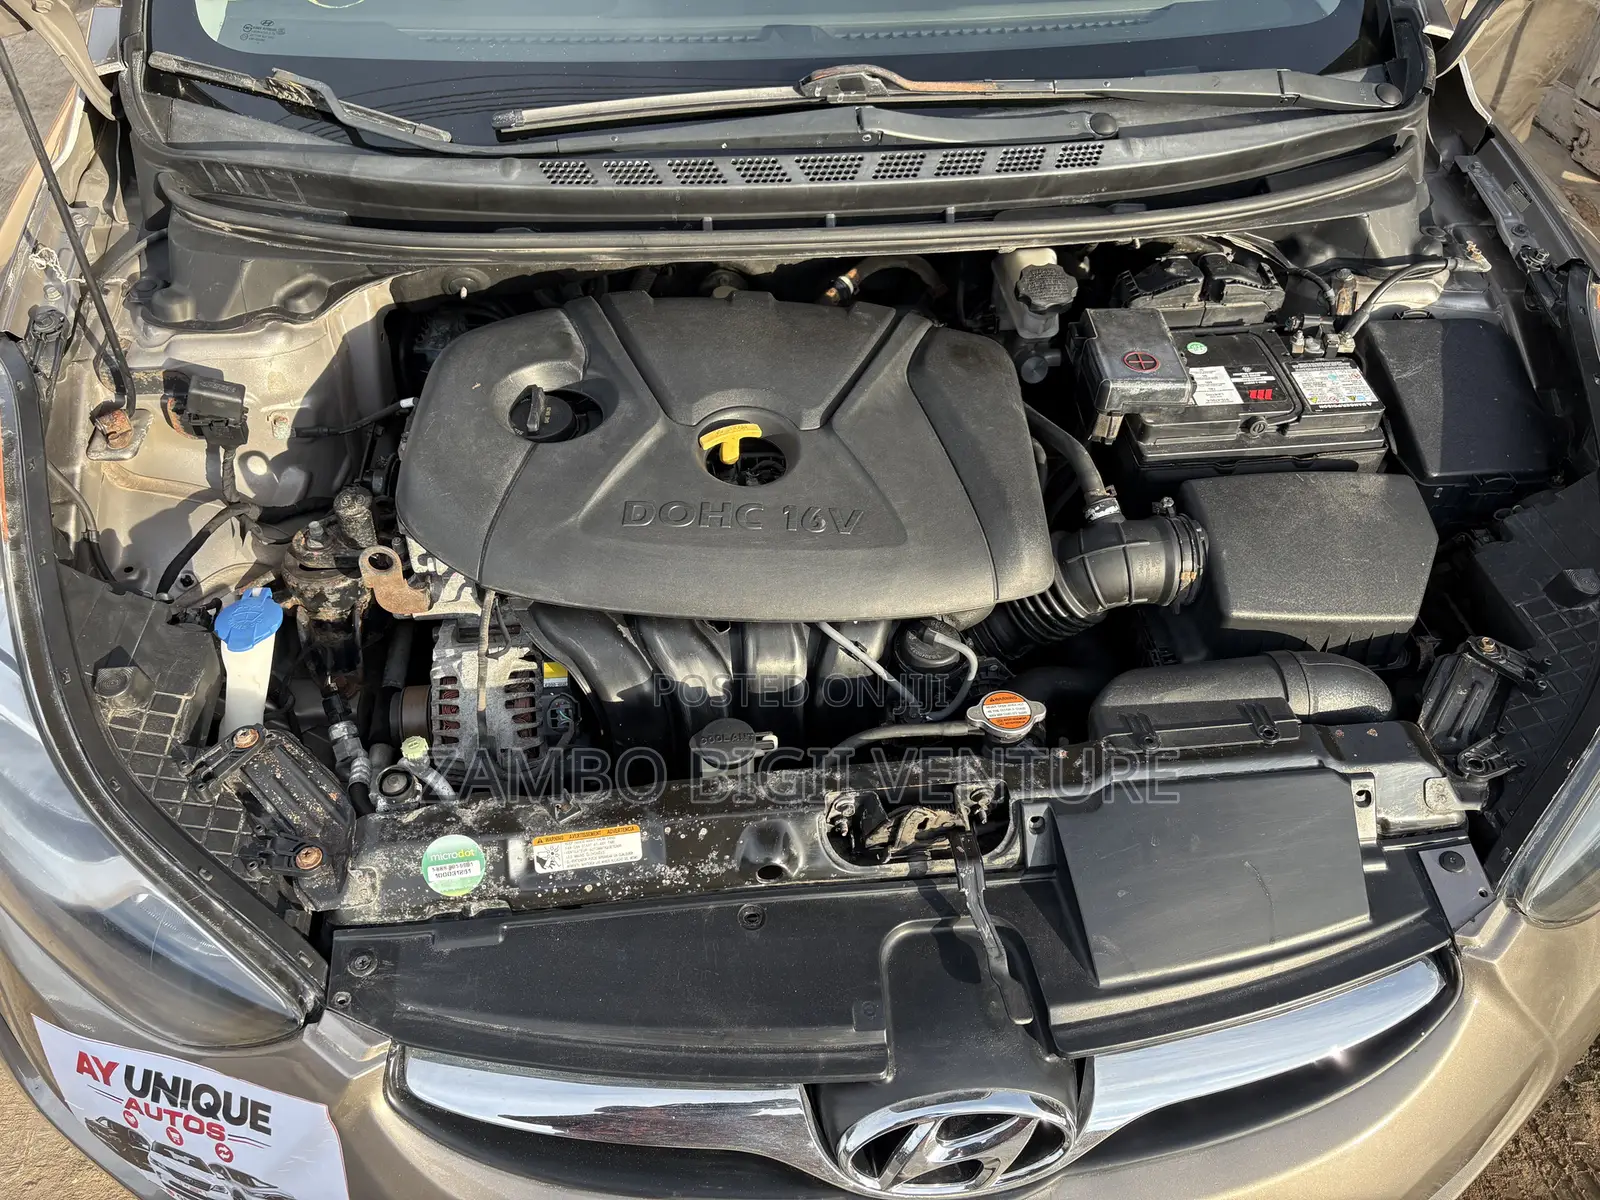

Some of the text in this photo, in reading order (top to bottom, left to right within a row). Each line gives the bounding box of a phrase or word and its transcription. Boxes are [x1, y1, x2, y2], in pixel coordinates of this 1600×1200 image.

[622, 500, 864, 535] DOHC 16V
[701, 732, 755, 744] COOLANT
[545, 835, 564, 843] WARNING
[607, 826, 635, 835] ADVERTENCIA
[430, 848, 475, 862] microdot
[76, 1050, 272, 1136] AY UNIQUE
[123, 1097, 226, 1140] AUTOS
